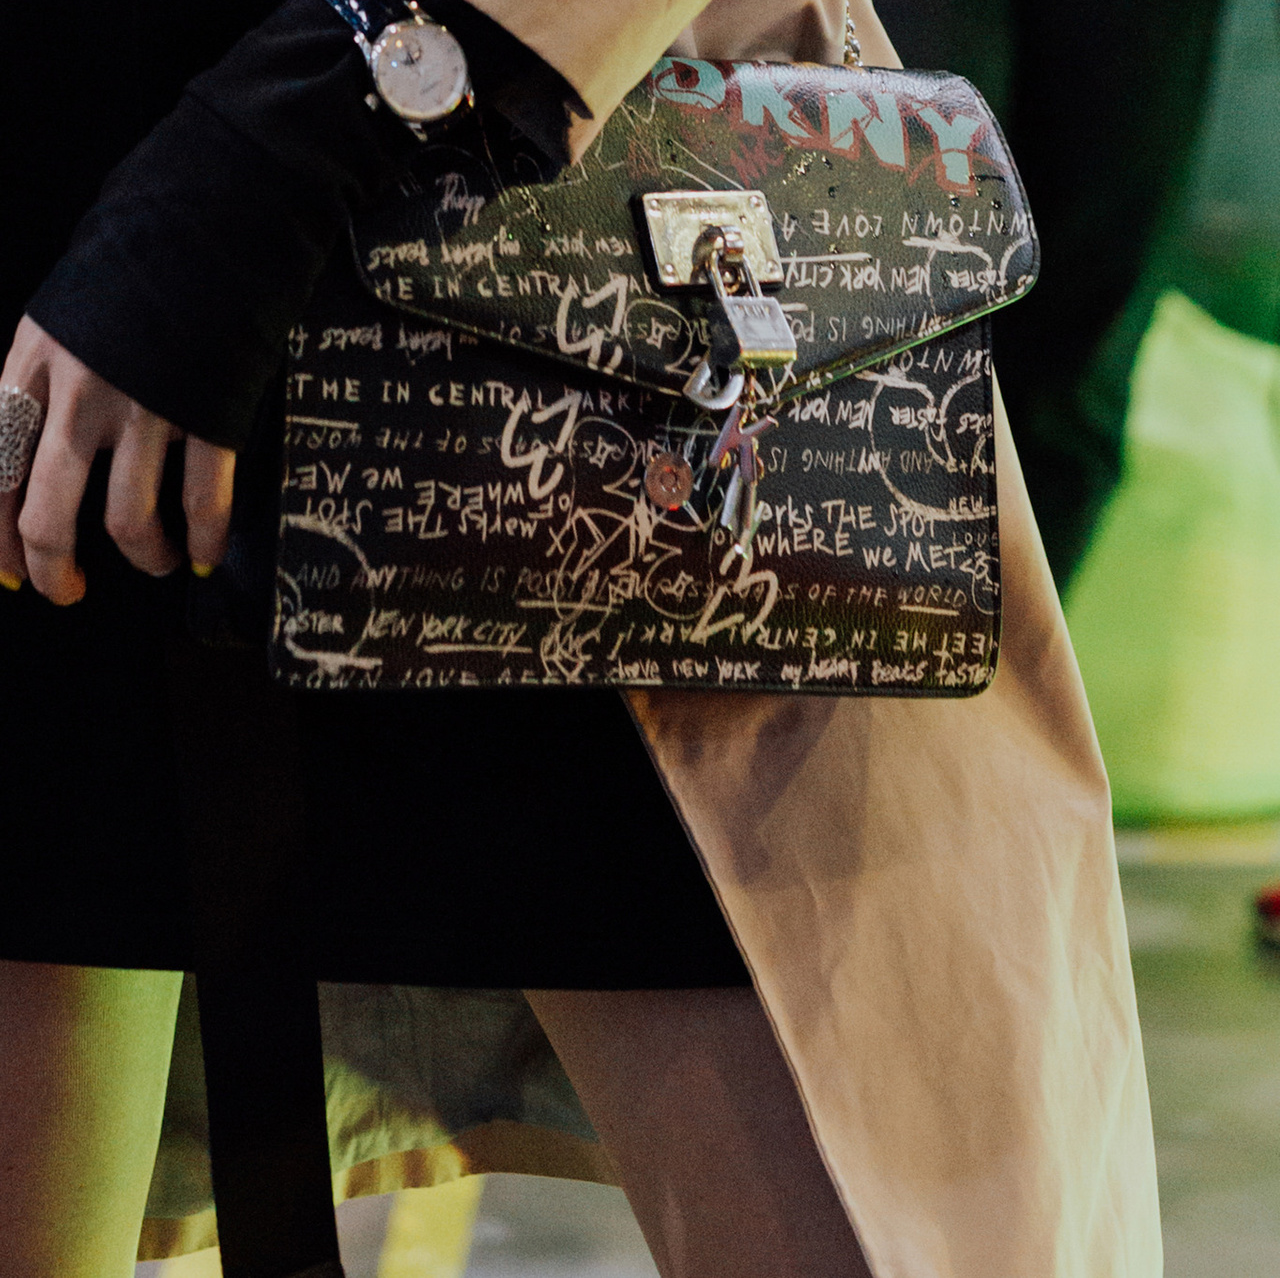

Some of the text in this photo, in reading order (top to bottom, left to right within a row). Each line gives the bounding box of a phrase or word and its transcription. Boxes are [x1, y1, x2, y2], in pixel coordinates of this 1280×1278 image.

[652, 57, 992, 194] DKNY
[811, 209, 884, 239] LOVE
[840, 258, 887, 292] YORK
[322, 376, 361, 403] ME
[383, 379, 410, 404] IN
[767, 448, 786, 472] IS
[900, 449, 935, 472] AND
[821, 499, 877, 536] THE
[884, 503, 937, 538] SPOT
[903, 545, 965, 573] MET
[852, 628, 876, 651] IN
